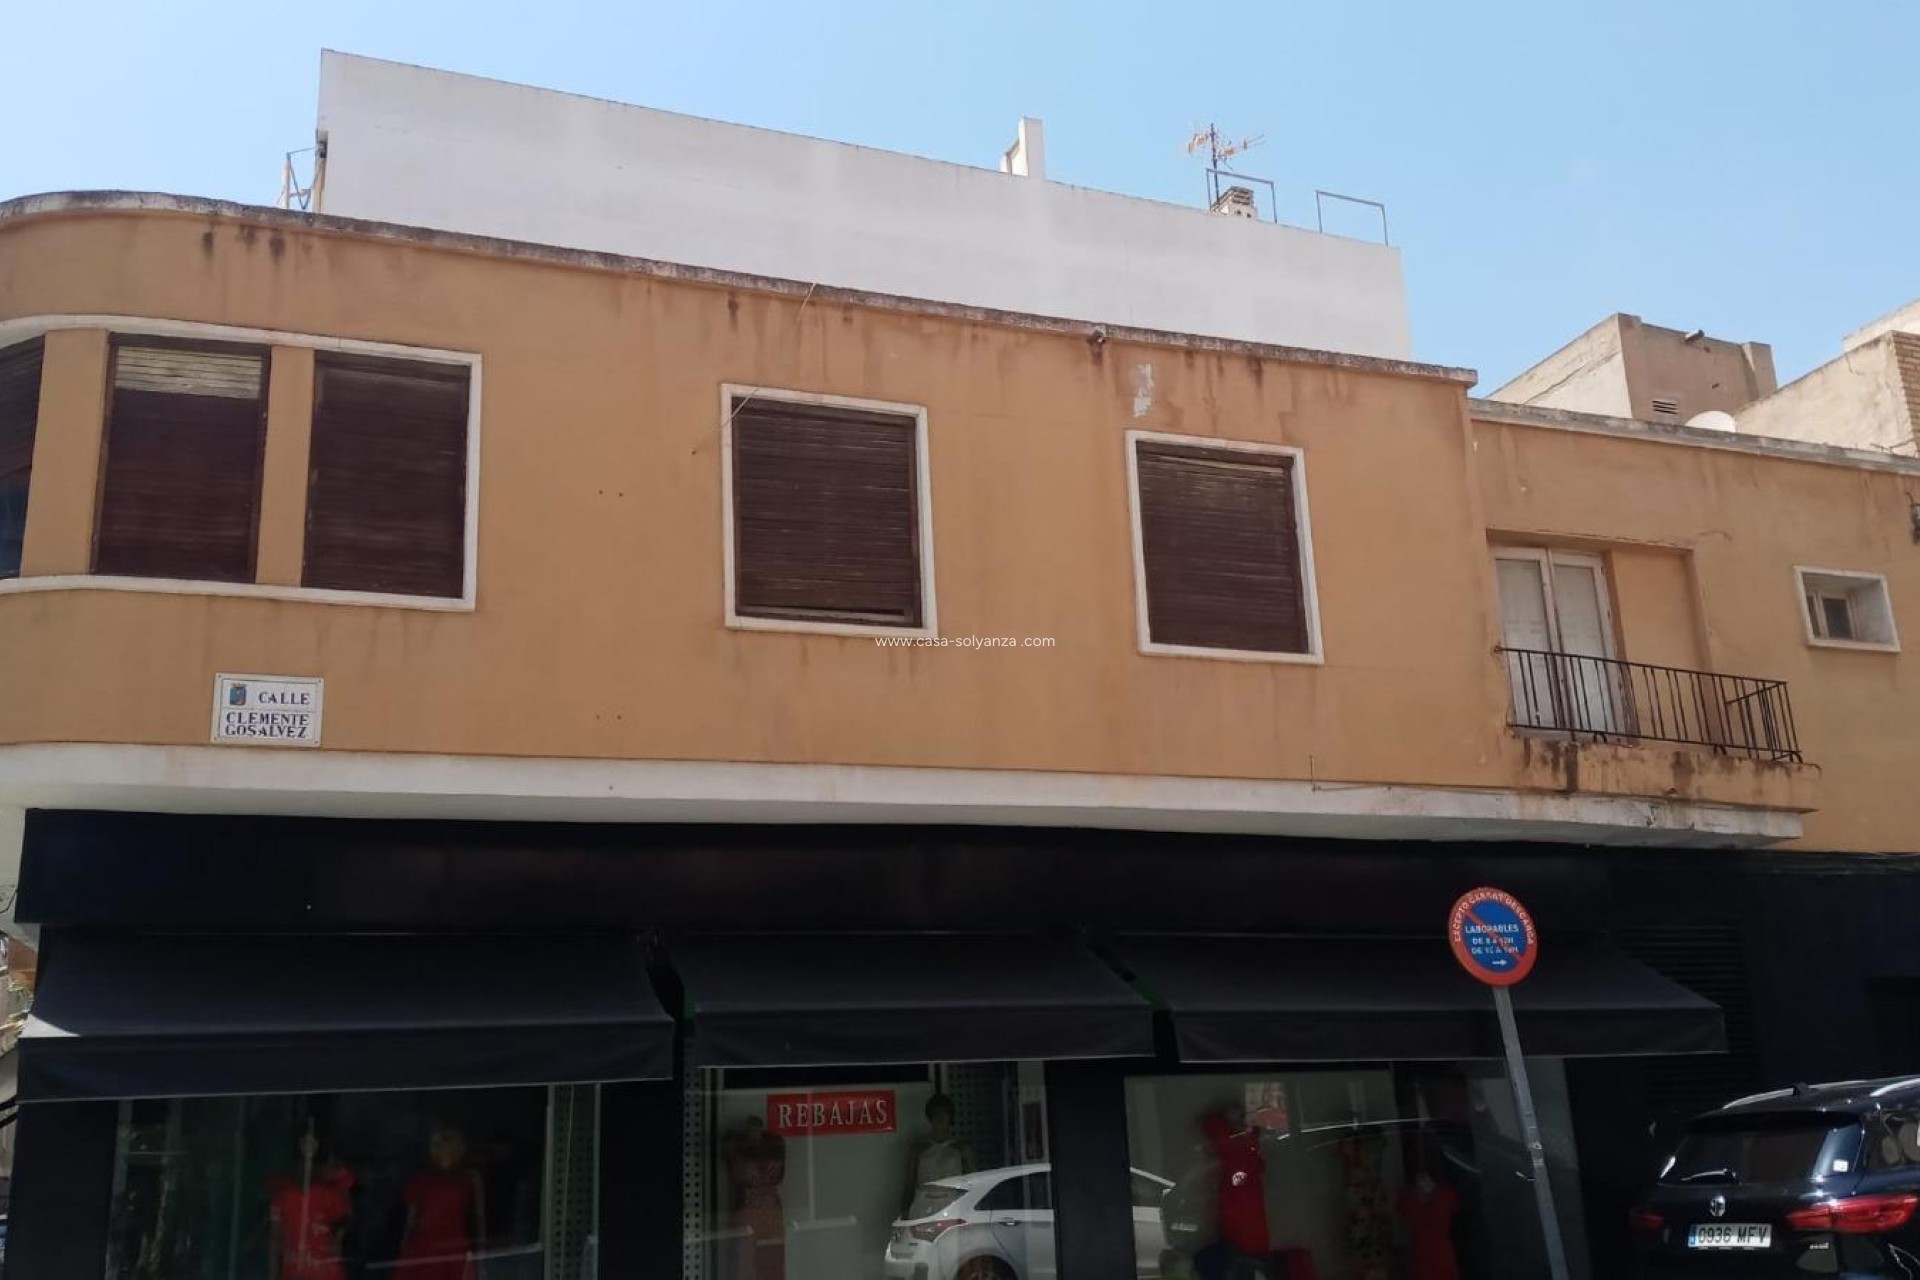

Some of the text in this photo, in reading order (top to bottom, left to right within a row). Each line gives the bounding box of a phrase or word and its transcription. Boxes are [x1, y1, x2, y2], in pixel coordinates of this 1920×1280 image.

[258, 691, 310, 705] CALLE
[226, 711, 309, 726] CLEMENTE
[225, 724, 307, 739] GOSALVEZ
[1465, 923, 1519, 934] LABORABLES
[1472, 936, 1483, 945] DE
[778, 1099, 888, 1128] REBAJAS
[1698, 1226, 1732, 1243] 0936
[1737, 1225, 1767, 1243] MFV
